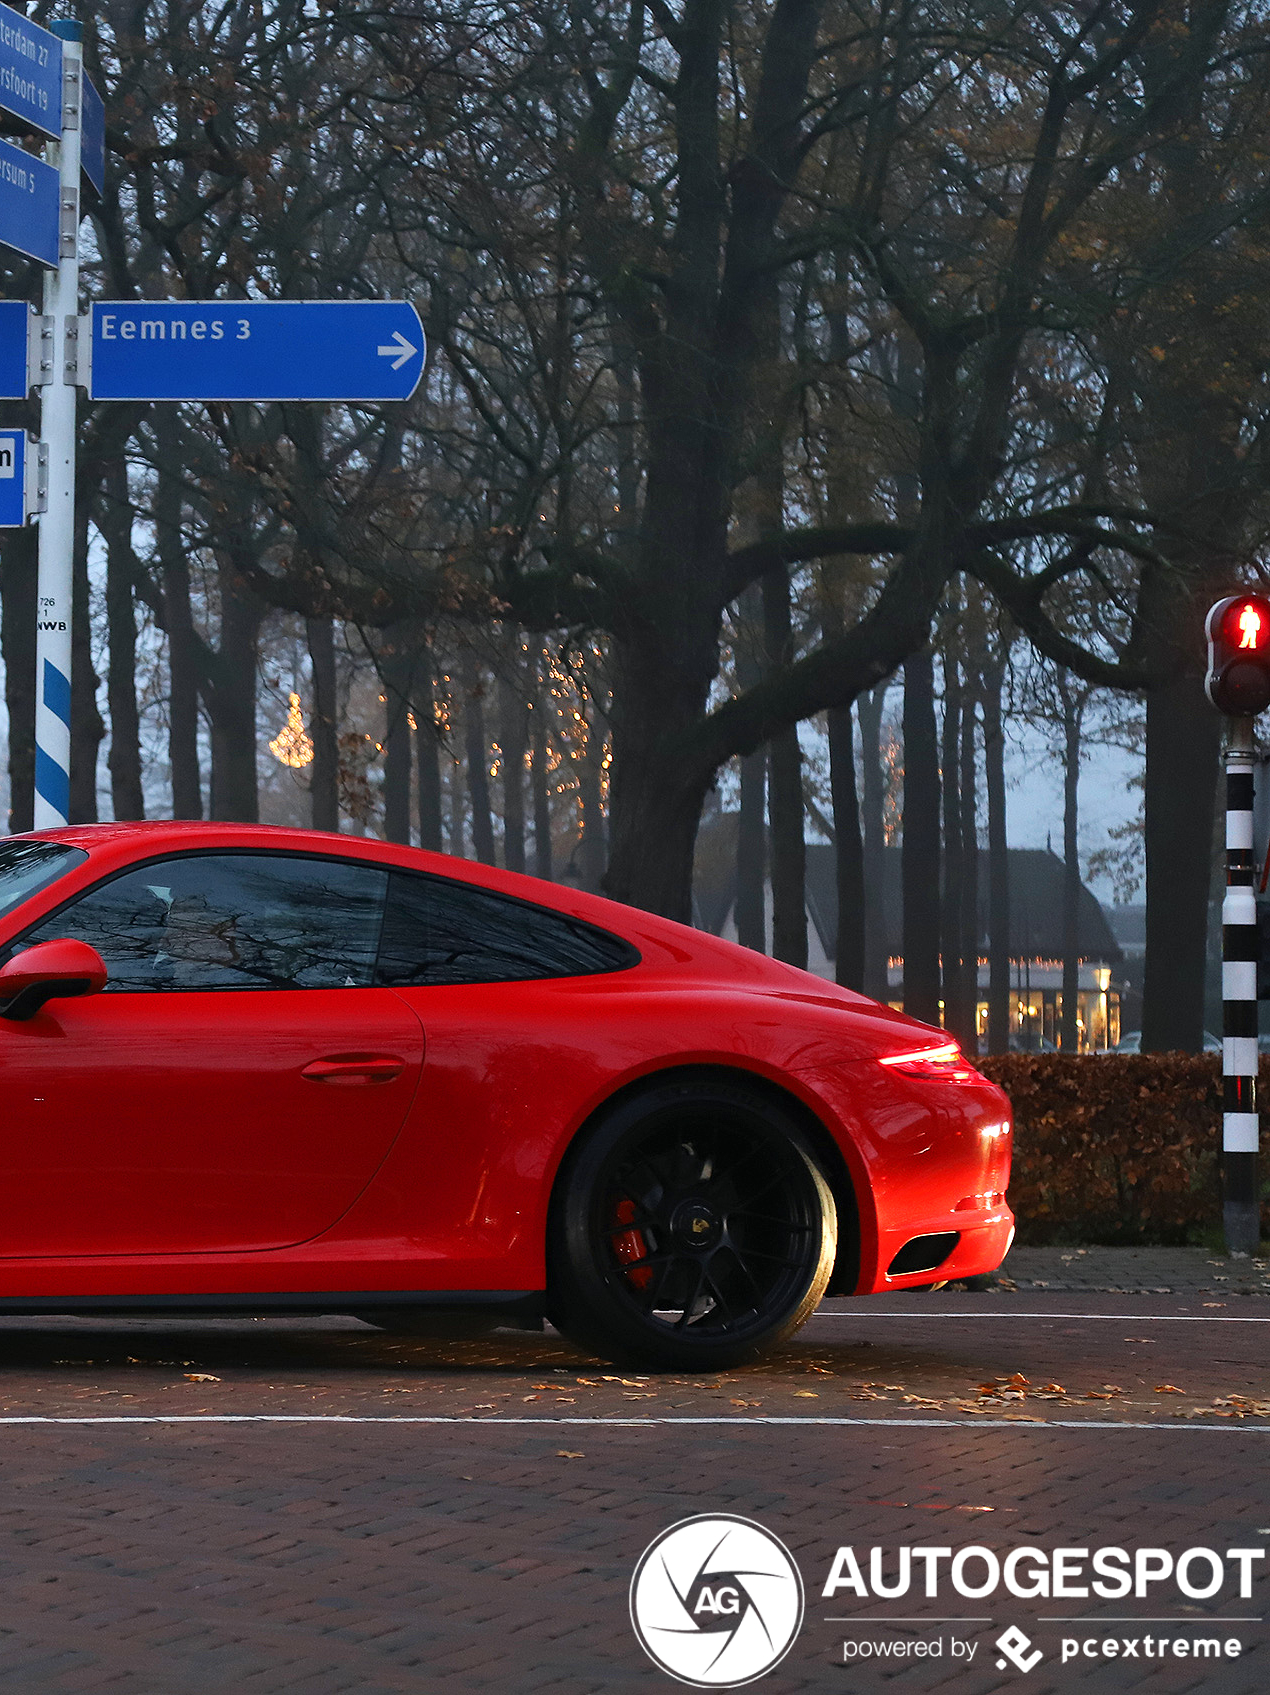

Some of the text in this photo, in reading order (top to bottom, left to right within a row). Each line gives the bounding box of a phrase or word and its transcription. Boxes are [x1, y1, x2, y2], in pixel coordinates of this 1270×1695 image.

[37, 45, 49, 67] 27
[37, 88, 48, 111] 19
[29, 173, 35, 194] 5
[101, 315, 252, 340] Eemnes 3
[37, 621, 67, 631] NWB
